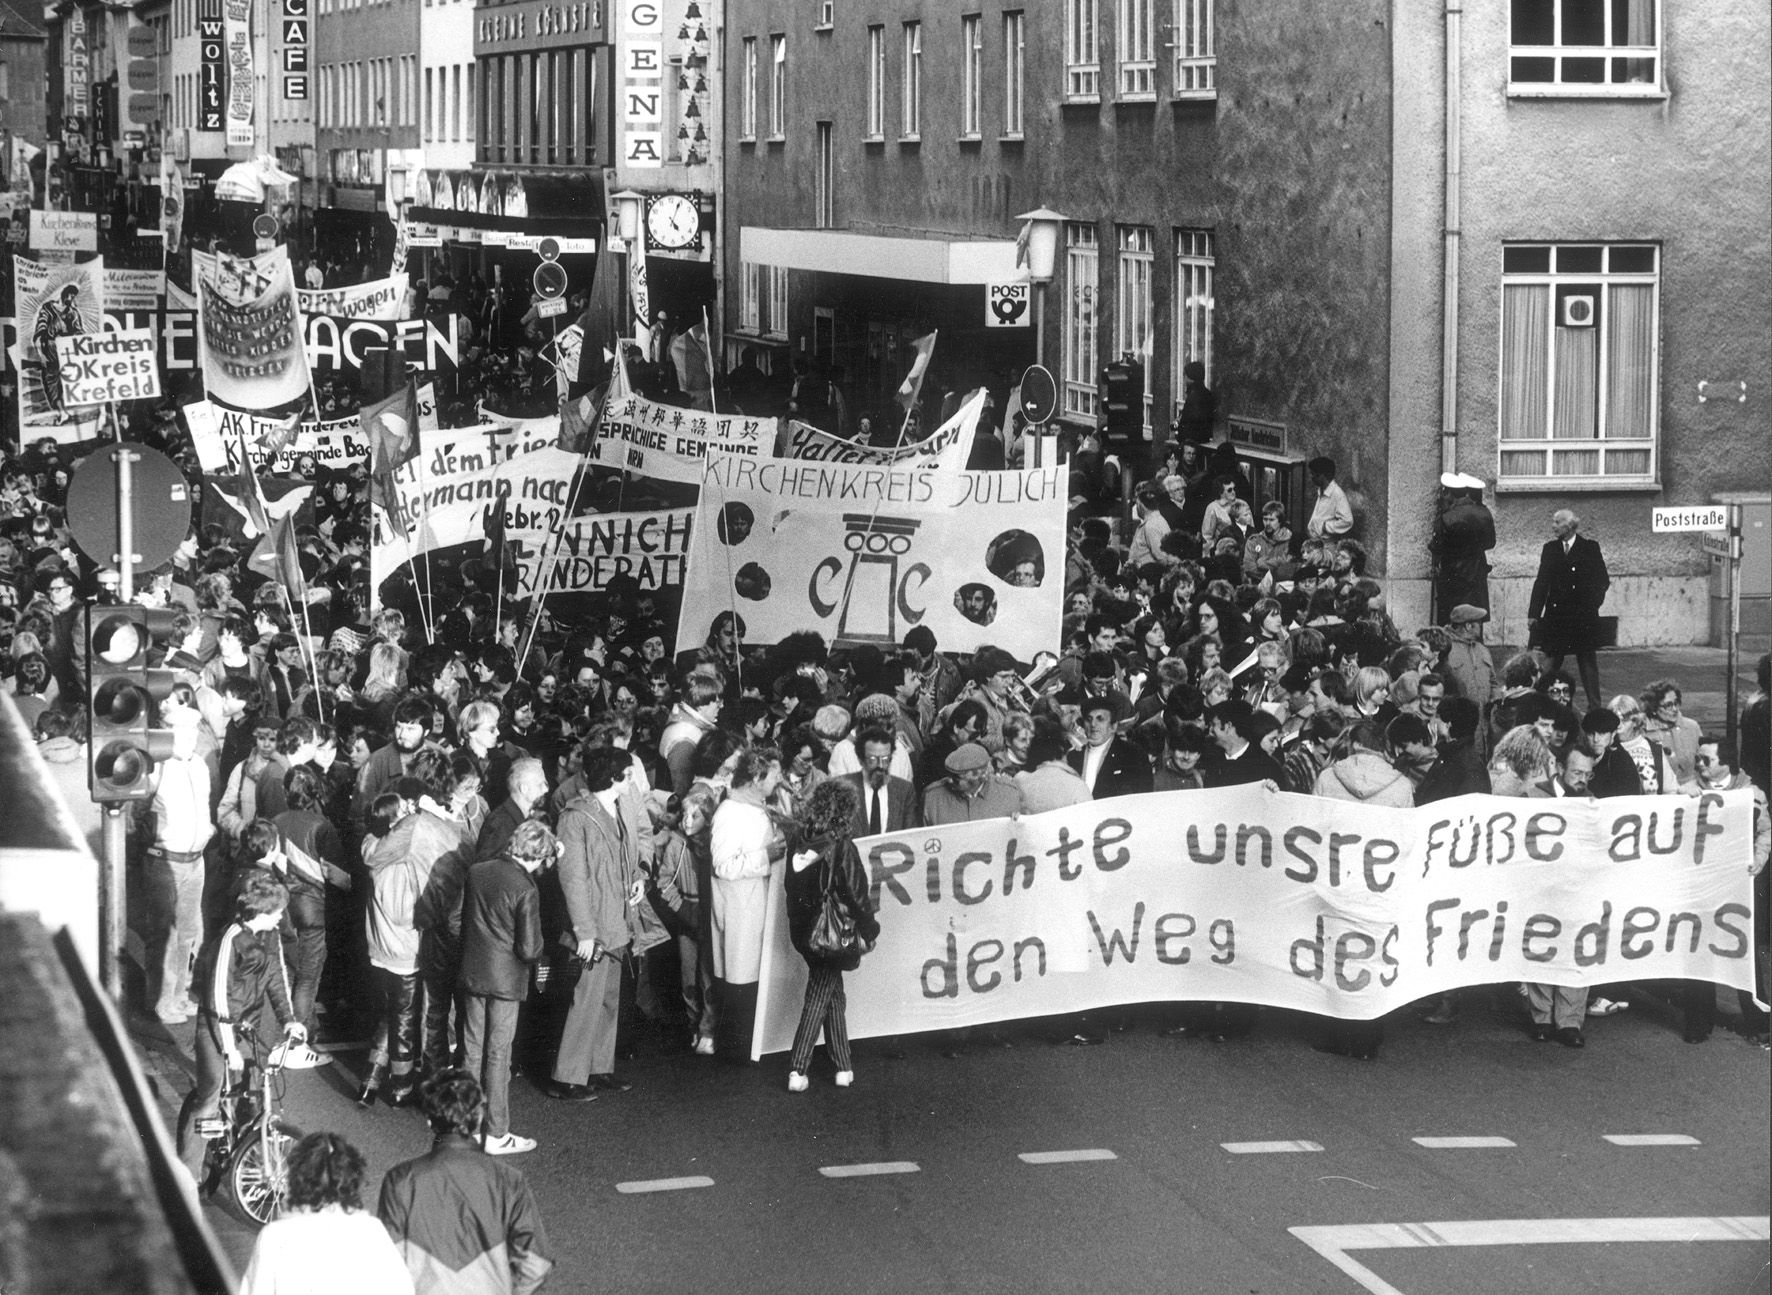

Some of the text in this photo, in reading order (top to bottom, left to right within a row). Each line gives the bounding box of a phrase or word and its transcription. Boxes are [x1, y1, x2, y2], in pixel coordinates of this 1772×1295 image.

[286, 0, 305, 98] CAFE
[628, 4, 660, 160] GENA
[343, 287, 396, 318] wagen
[991, 285, 1028, 298] POST
[72, 333, 153, 356] Kirchen
[83, 355, 151, 380] Kreis
[65, 374, 154, 403] Krefeld
[430, 448, 484, 477] dem
[703, 456, 933, 502] KIRCHENKREIS
[1655, 510, 1724, 528] Poststraße
[516, 514, 689, 560] LINNICH
[868, 793, 1724, 906] Richte unsre Füße auf
[920, 897, 1752, 998] den Weg des Friedens
